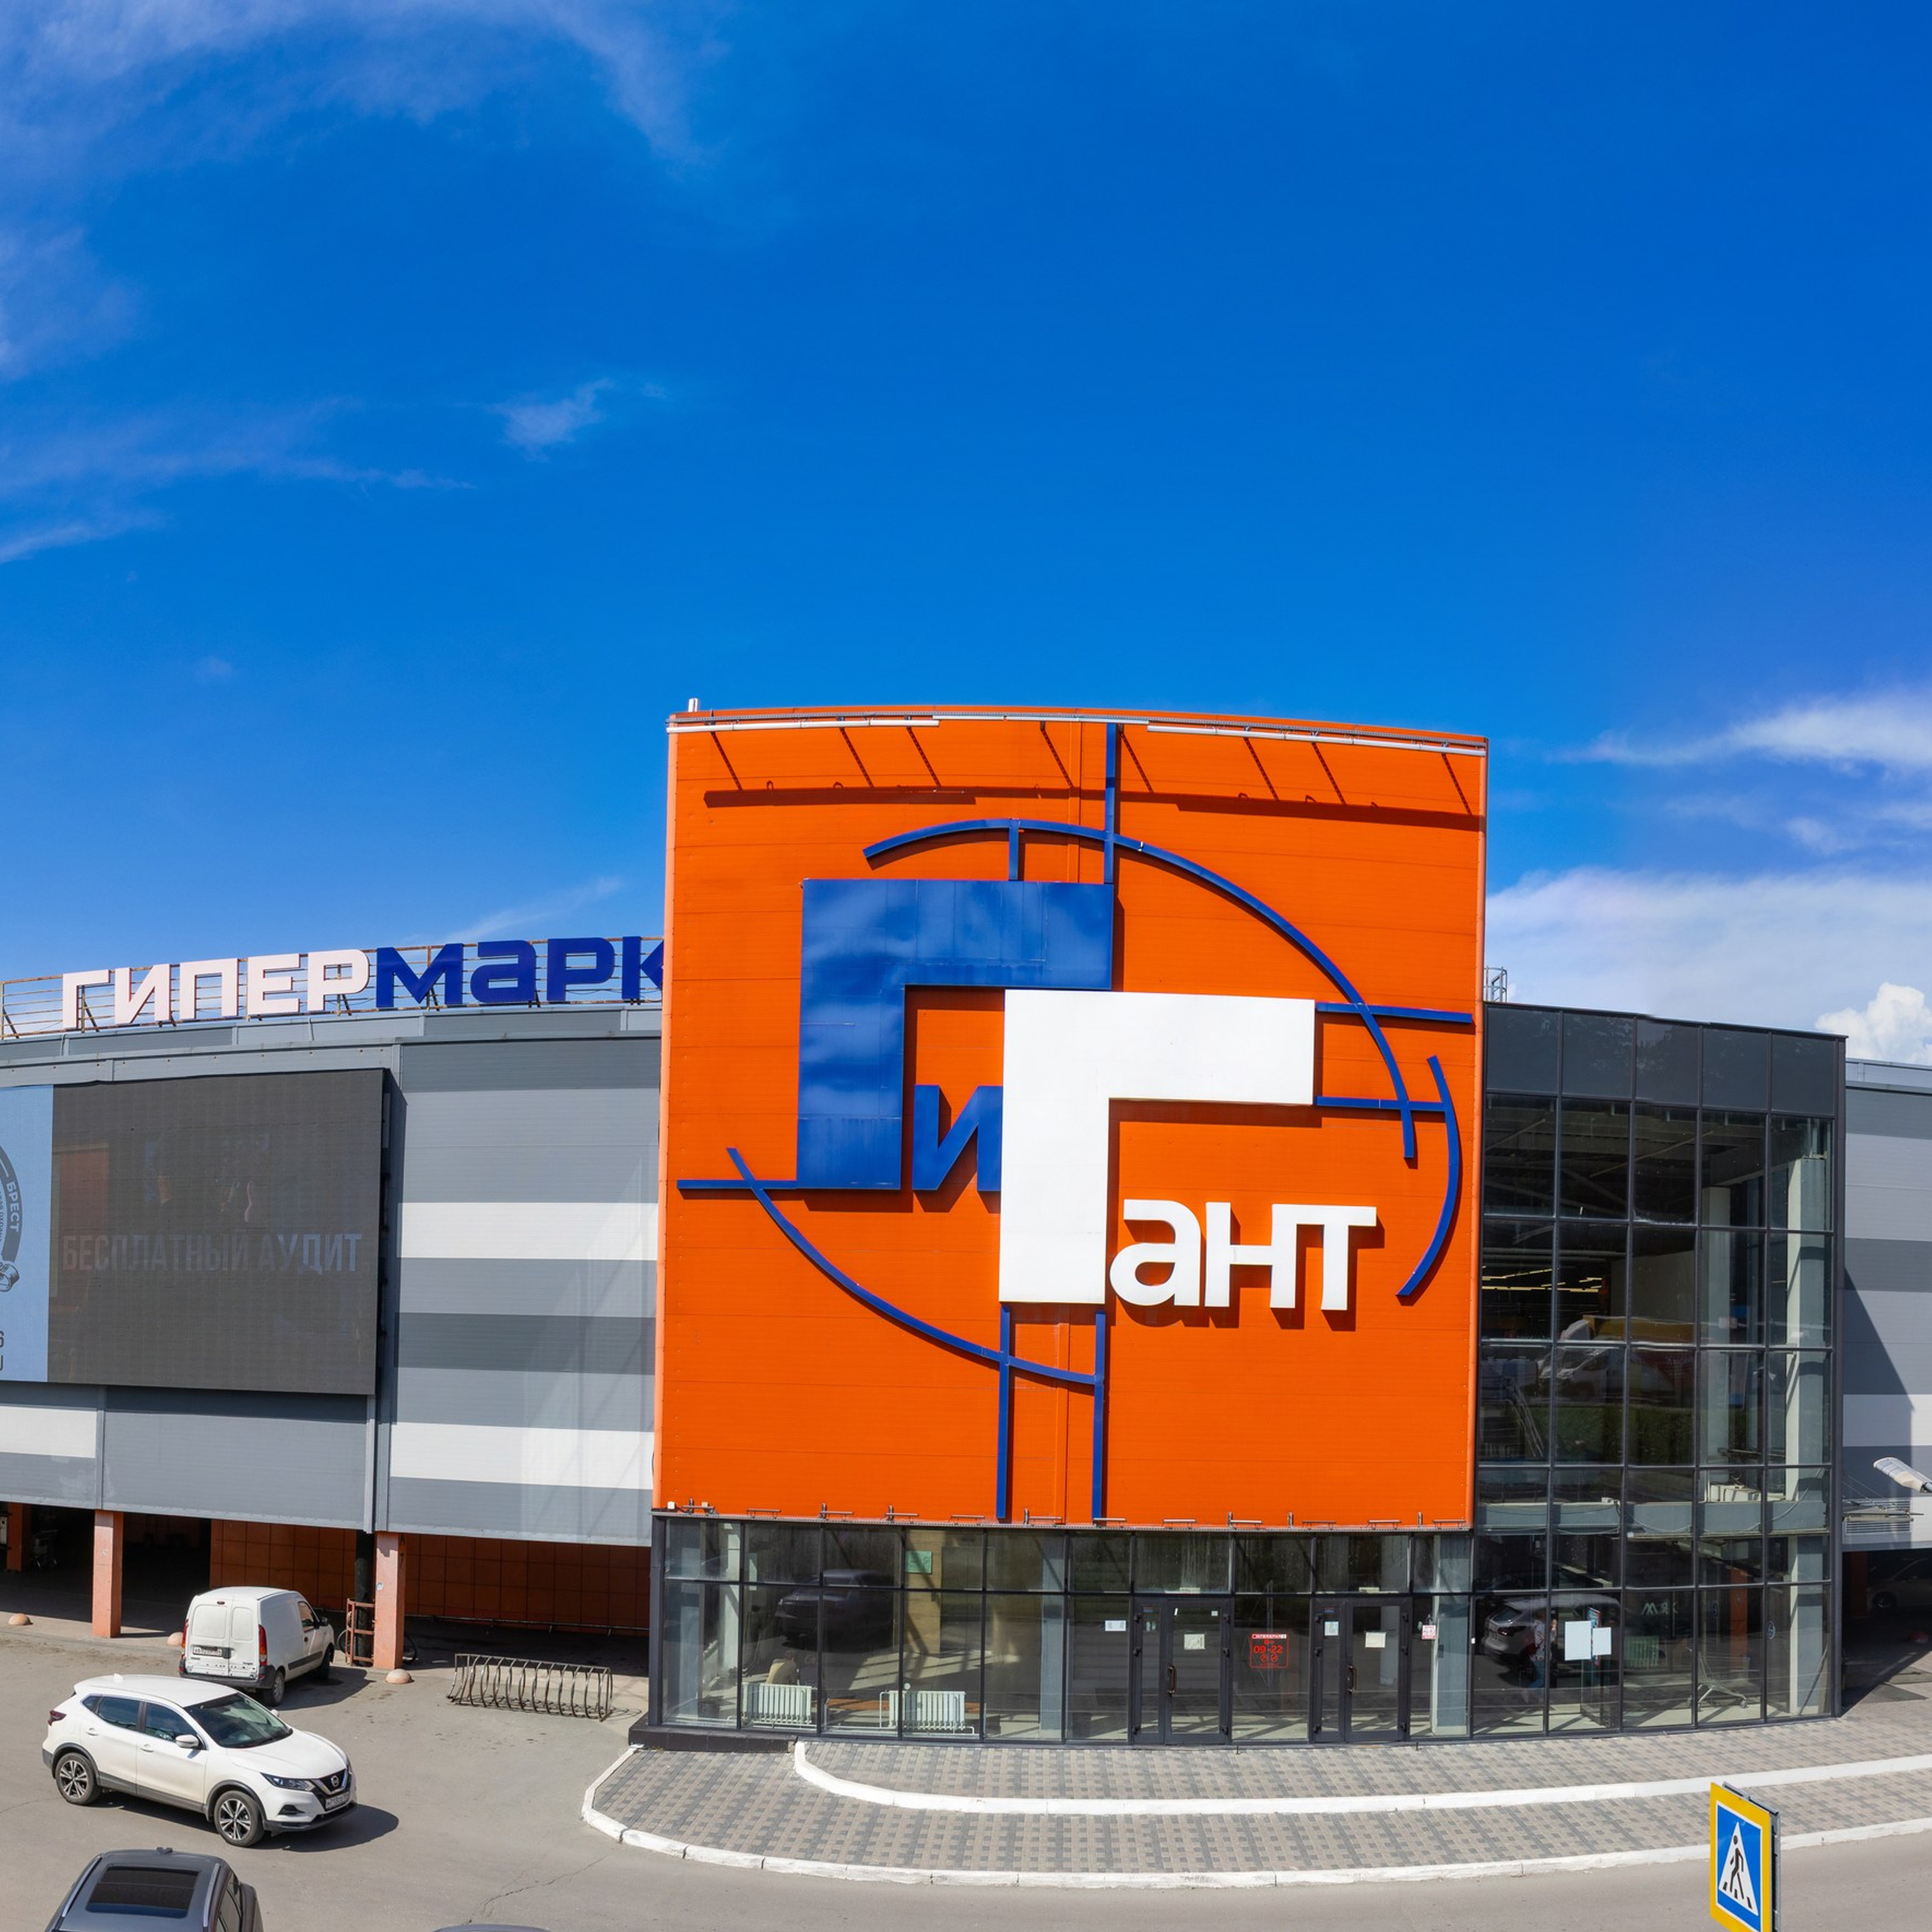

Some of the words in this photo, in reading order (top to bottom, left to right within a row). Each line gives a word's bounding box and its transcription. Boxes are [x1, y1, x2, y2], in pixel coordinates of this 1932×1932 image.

[6, 1180, 20, 1232] БРЕСТ
[62, 1232, 250, 1273] БЕСПЛАТНЫЙ
[257, 1233, 363, 1276] АУДИТ
